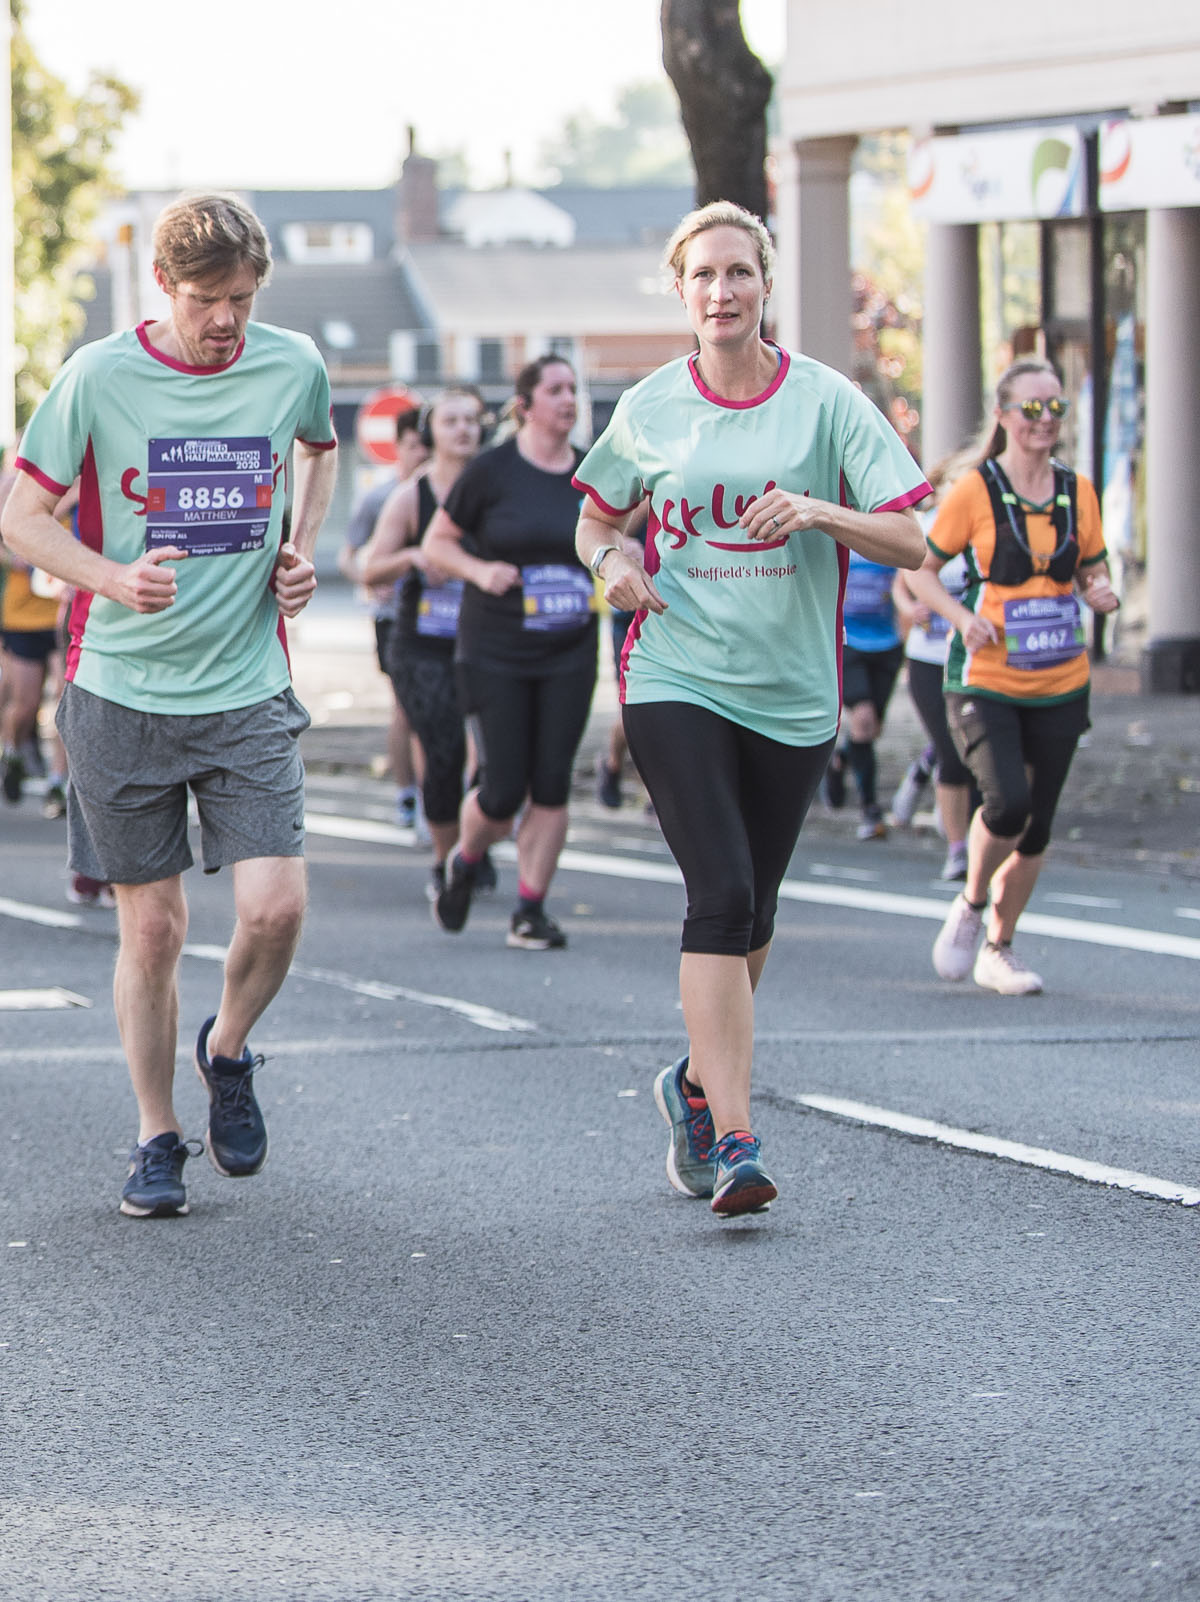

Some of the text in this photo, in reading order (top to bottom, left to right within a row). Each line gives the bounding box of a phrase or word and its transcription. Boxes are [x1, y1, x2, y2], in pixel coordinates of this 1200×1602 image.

[207, 451, 260, 462] MARATHON
[236, 461, 260, 469] 2020
[254, 474, 263, 484] M
[178, 486, 244, 509] 8856
[184, 510, 238, 522] MATTHEW
[687, 566, 751, 581] Sheffield's
